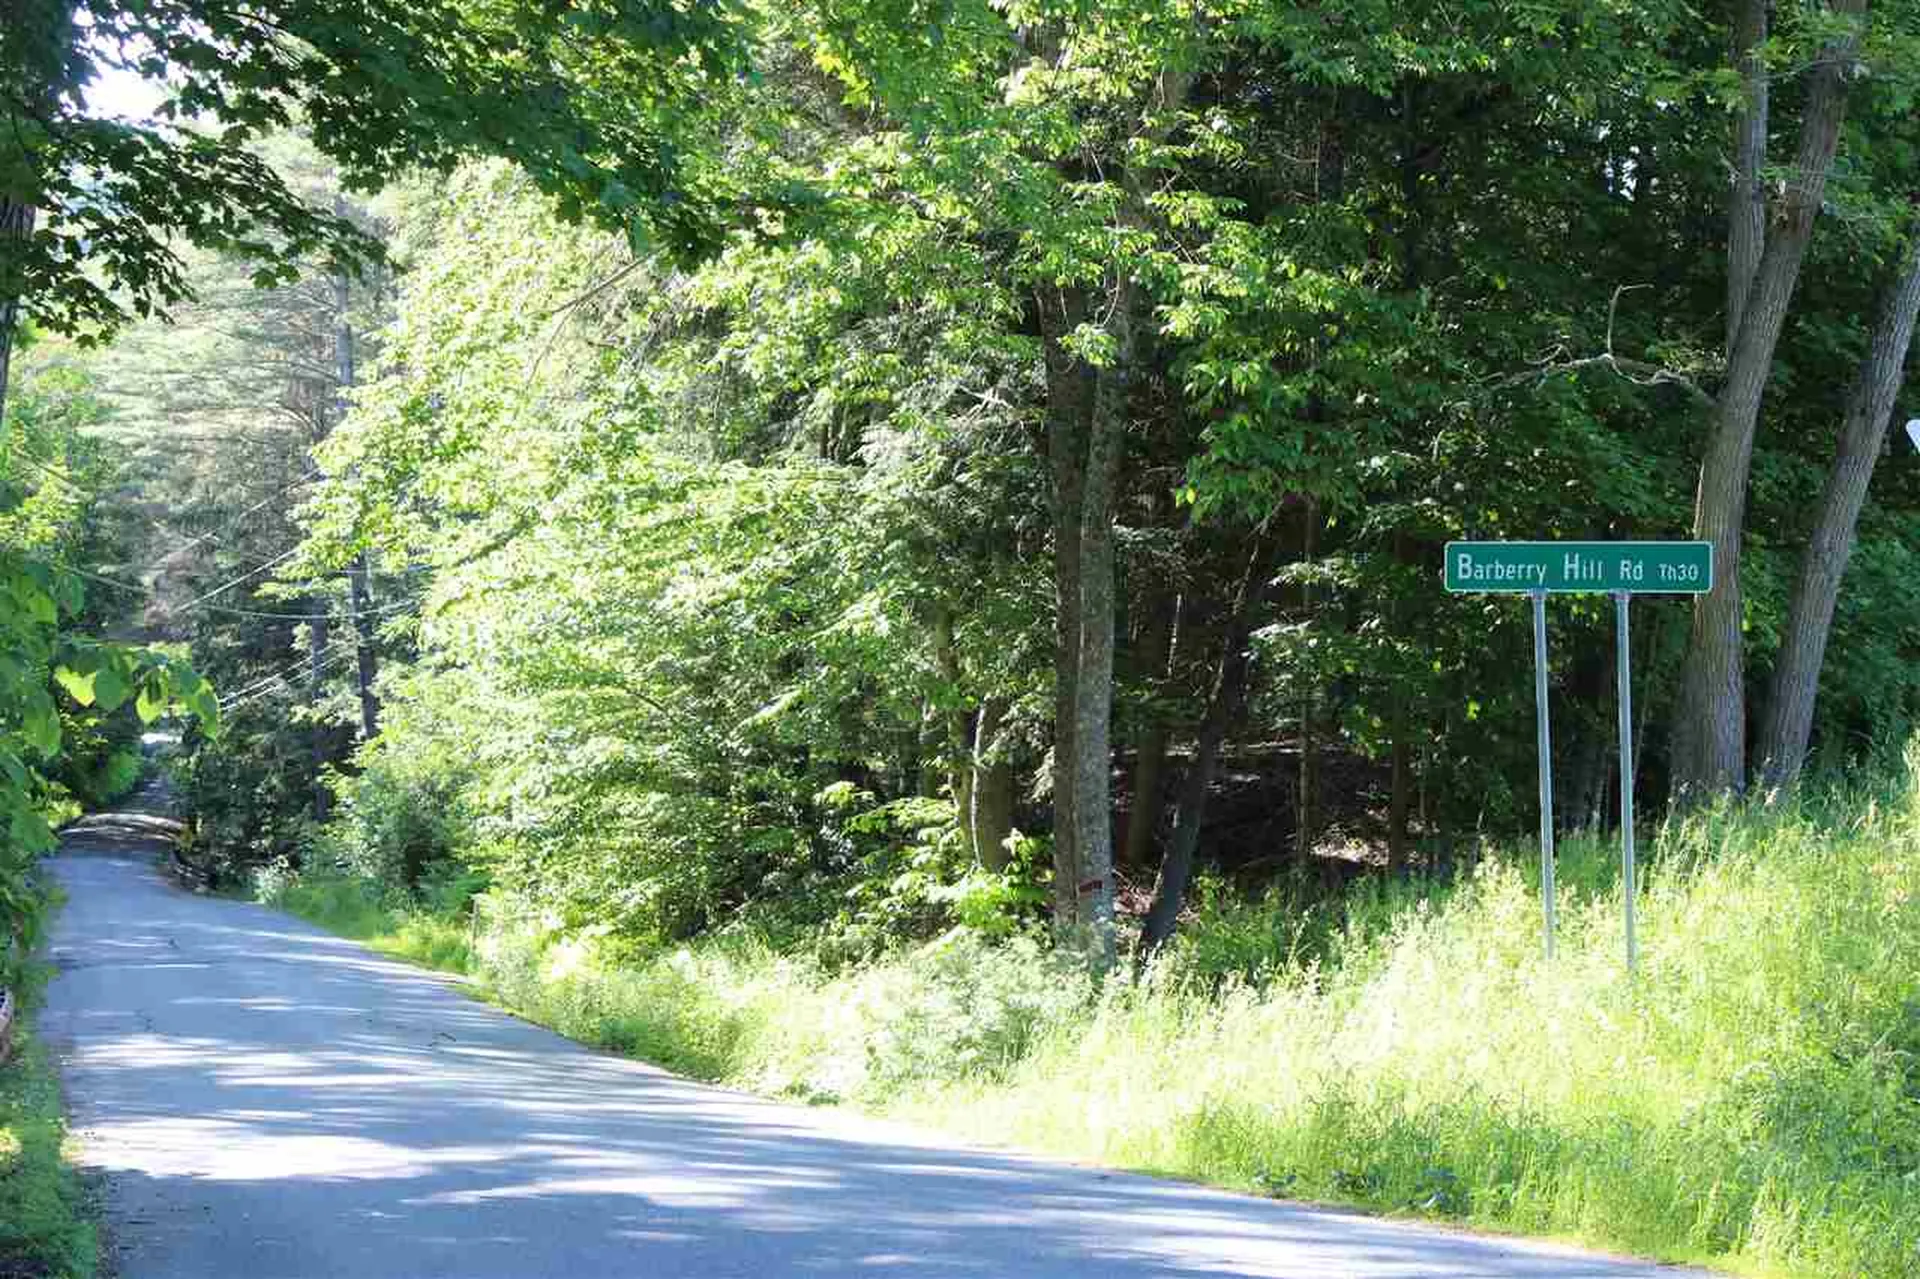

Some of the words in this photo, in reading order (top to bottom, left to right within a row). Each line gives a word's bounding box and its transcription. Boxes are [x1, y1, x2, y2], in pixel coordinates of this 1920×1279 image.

[1457, 552, 1547, 584] Barberry
[1563, 552, 1604, 581] Hill
[1619, 559, 1644, 581] Rd
